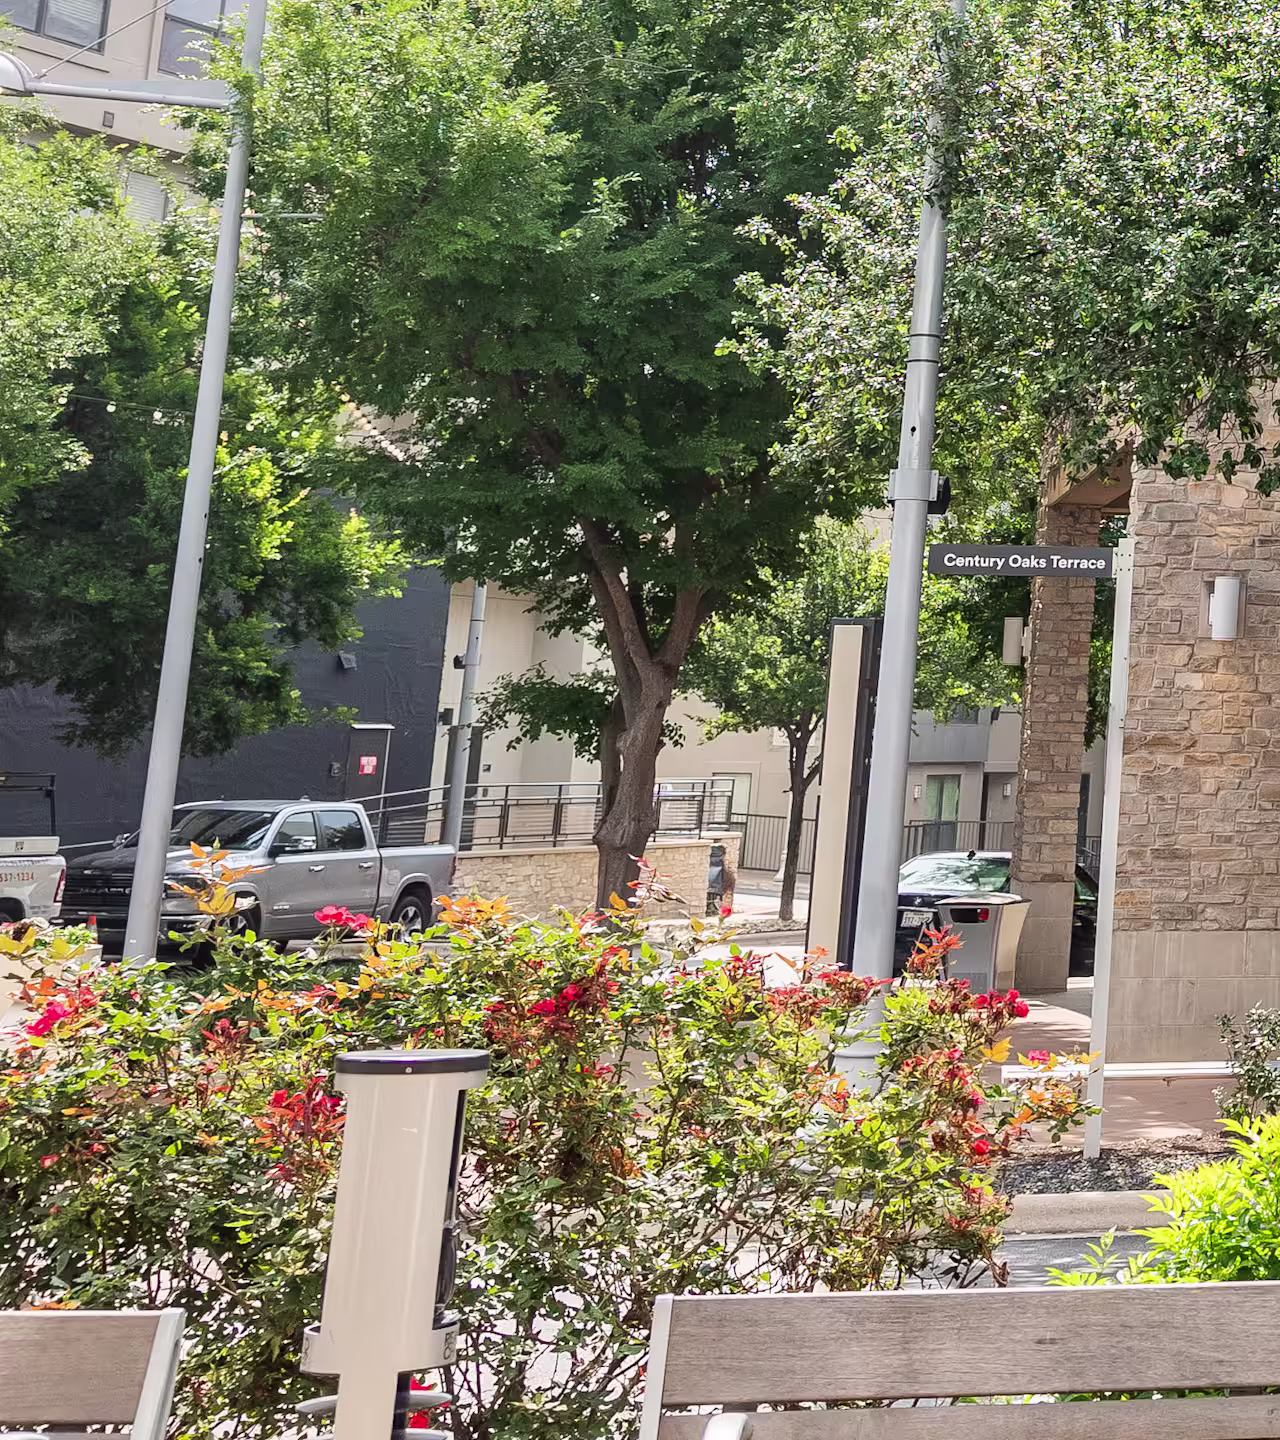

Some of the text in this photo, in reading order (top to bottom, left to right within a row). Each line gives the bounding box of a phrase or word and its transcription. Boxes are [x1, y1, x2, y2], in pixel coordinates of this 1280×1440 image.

[943, 553, 1106, 571] Century Oaks Terrace
